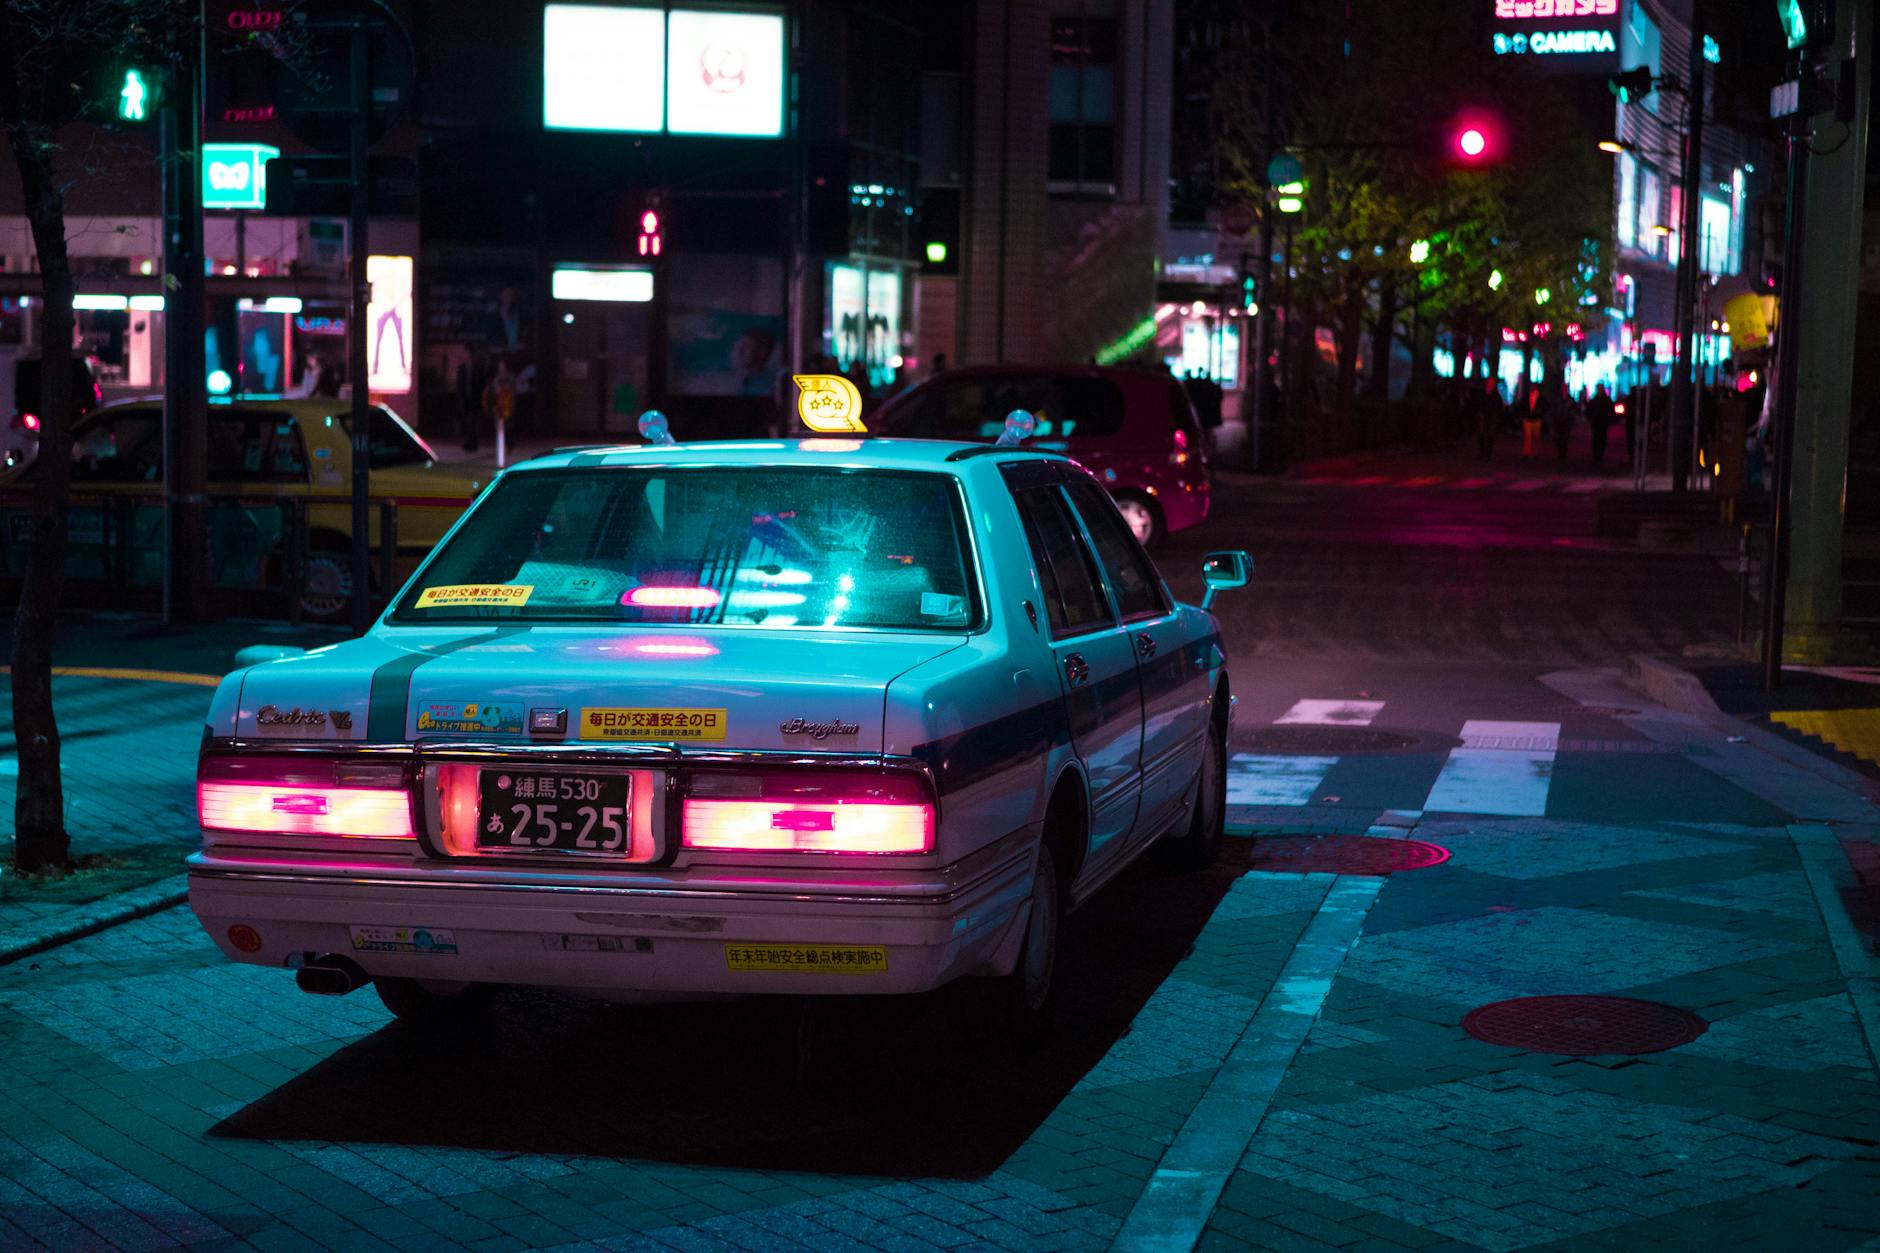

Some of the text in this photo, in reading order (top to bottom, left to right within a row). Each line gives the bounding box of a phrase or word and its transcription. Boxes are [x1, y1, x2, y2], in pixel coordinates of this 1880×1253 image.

[1530, 30, 1616, 54] CAMERA
[256, 704, 327, 725] Cedric
[589, 712, 717, 727] 毎日が交通安全の日
[780, 717, 860, 740] Brougham
[514, 777, 599, 801] 練馬 530
[486, 803, 625, 850] あ 25-25
